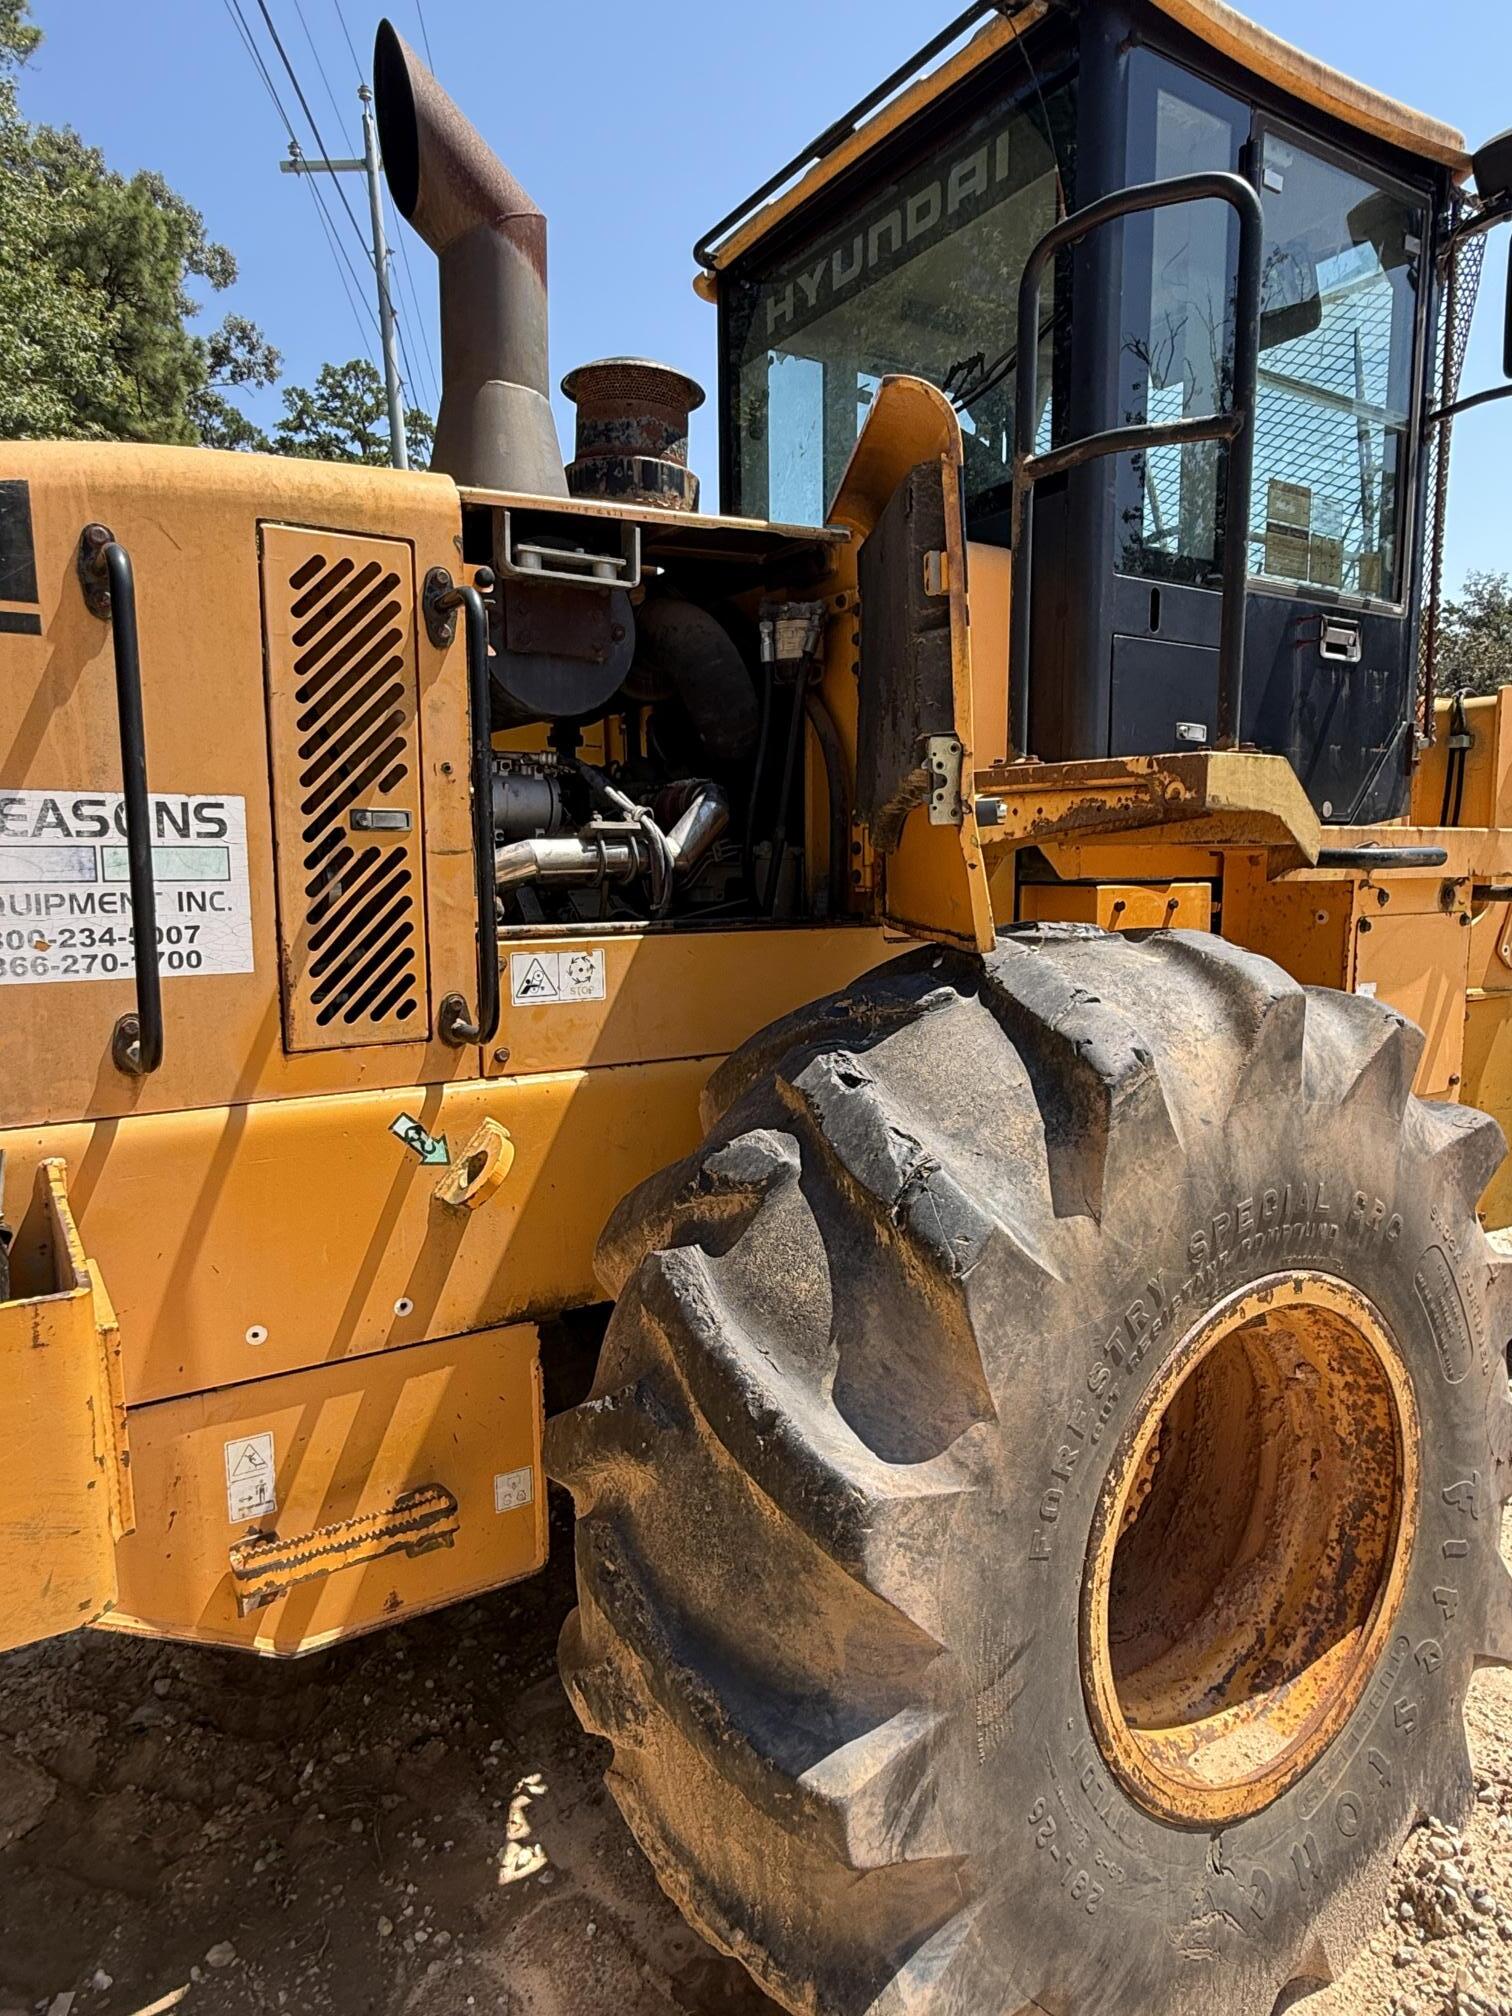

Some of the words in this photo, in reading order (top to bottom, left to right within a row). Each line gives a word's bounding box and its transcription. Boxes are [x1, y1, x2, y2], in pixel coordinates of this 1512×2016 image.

[767, 131, 1009, 334] HYUNDAI
[0, 890, 163, 916] UIPMEN
[178, 890, 232, 913] INC.
[0, 925, 201, 951] 00-234-007
[0, 951, 203, 977] 66-270-00
[570, 986, 595, 995] STOP
[1030, 1271, 1165, 1562] FORESTRY
[1187, 1182, 1330, 1264] SPECIAL
[1303, 1645, 1406, 1808] TUBELESS
[1028, 1797, 1105, 1915] 28L-26
